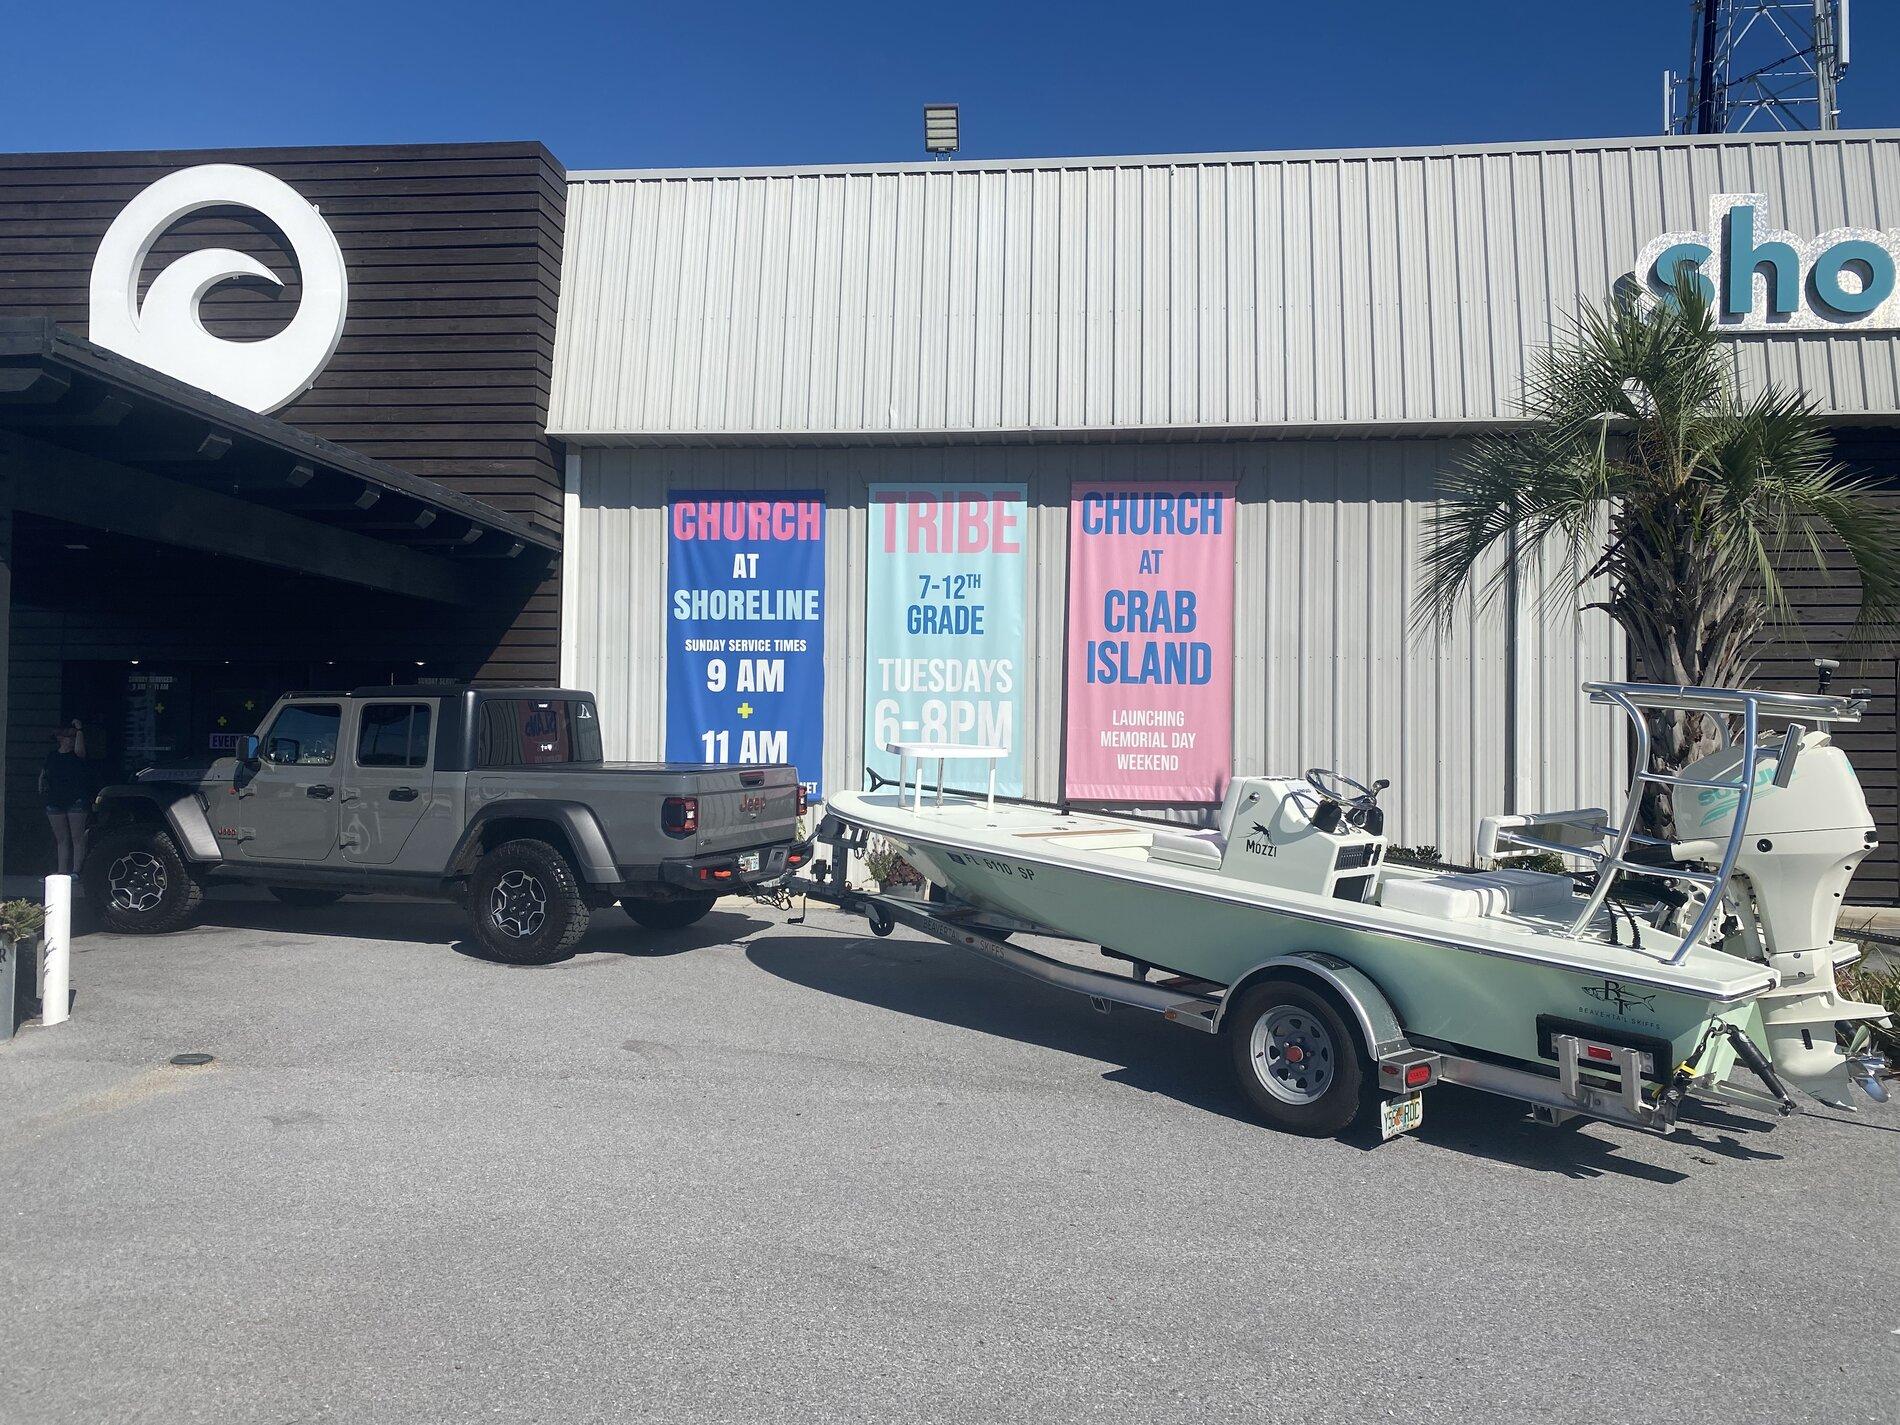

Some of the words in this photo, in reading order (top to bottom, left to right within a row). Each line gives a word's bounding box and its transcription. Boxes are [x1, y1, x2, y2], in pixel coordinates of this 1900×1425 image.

[673, 499, 821, 541] CHURCH
[875, 491, 1022, 554] TRIBE
[1082, 491, 1224, 535] CHURCH
[732, 553, 760, 579] AT
[1139, 549, 1164, 575] AT
[673, 589, 820, 621] SHORELINE
[907, 605, 985, 635] GRADE
[1103, 589, 1198, 634] CRAB
[685, 639, 726, 652] SUNDAY
[728, 639, 771, 652] SERVICE
[774, 639, 807, 652] TIMES
[706, 658, 727, 692] 9
[736, 659, 785, 692] AM
[878, 658, 1014, 693] TUESDAYS
[1086, 641, 1212, 685] ISLAND
[874, 699, 1013, 750] 6-8PM
[1112, 710, 1185, 727] LAUNCHING
[702, 730, 729, 763] 11
[739, 730, 788, 763] AM
[1100, 731, 1168, 748] MEMORIAL
[1171, 732, 1196, 749] DAY
[1117, 754, 1179, 771] WEEKEND
[1245, 839, 1277, 858] MOZZI
[1018, 866, 1035, 881] SP
